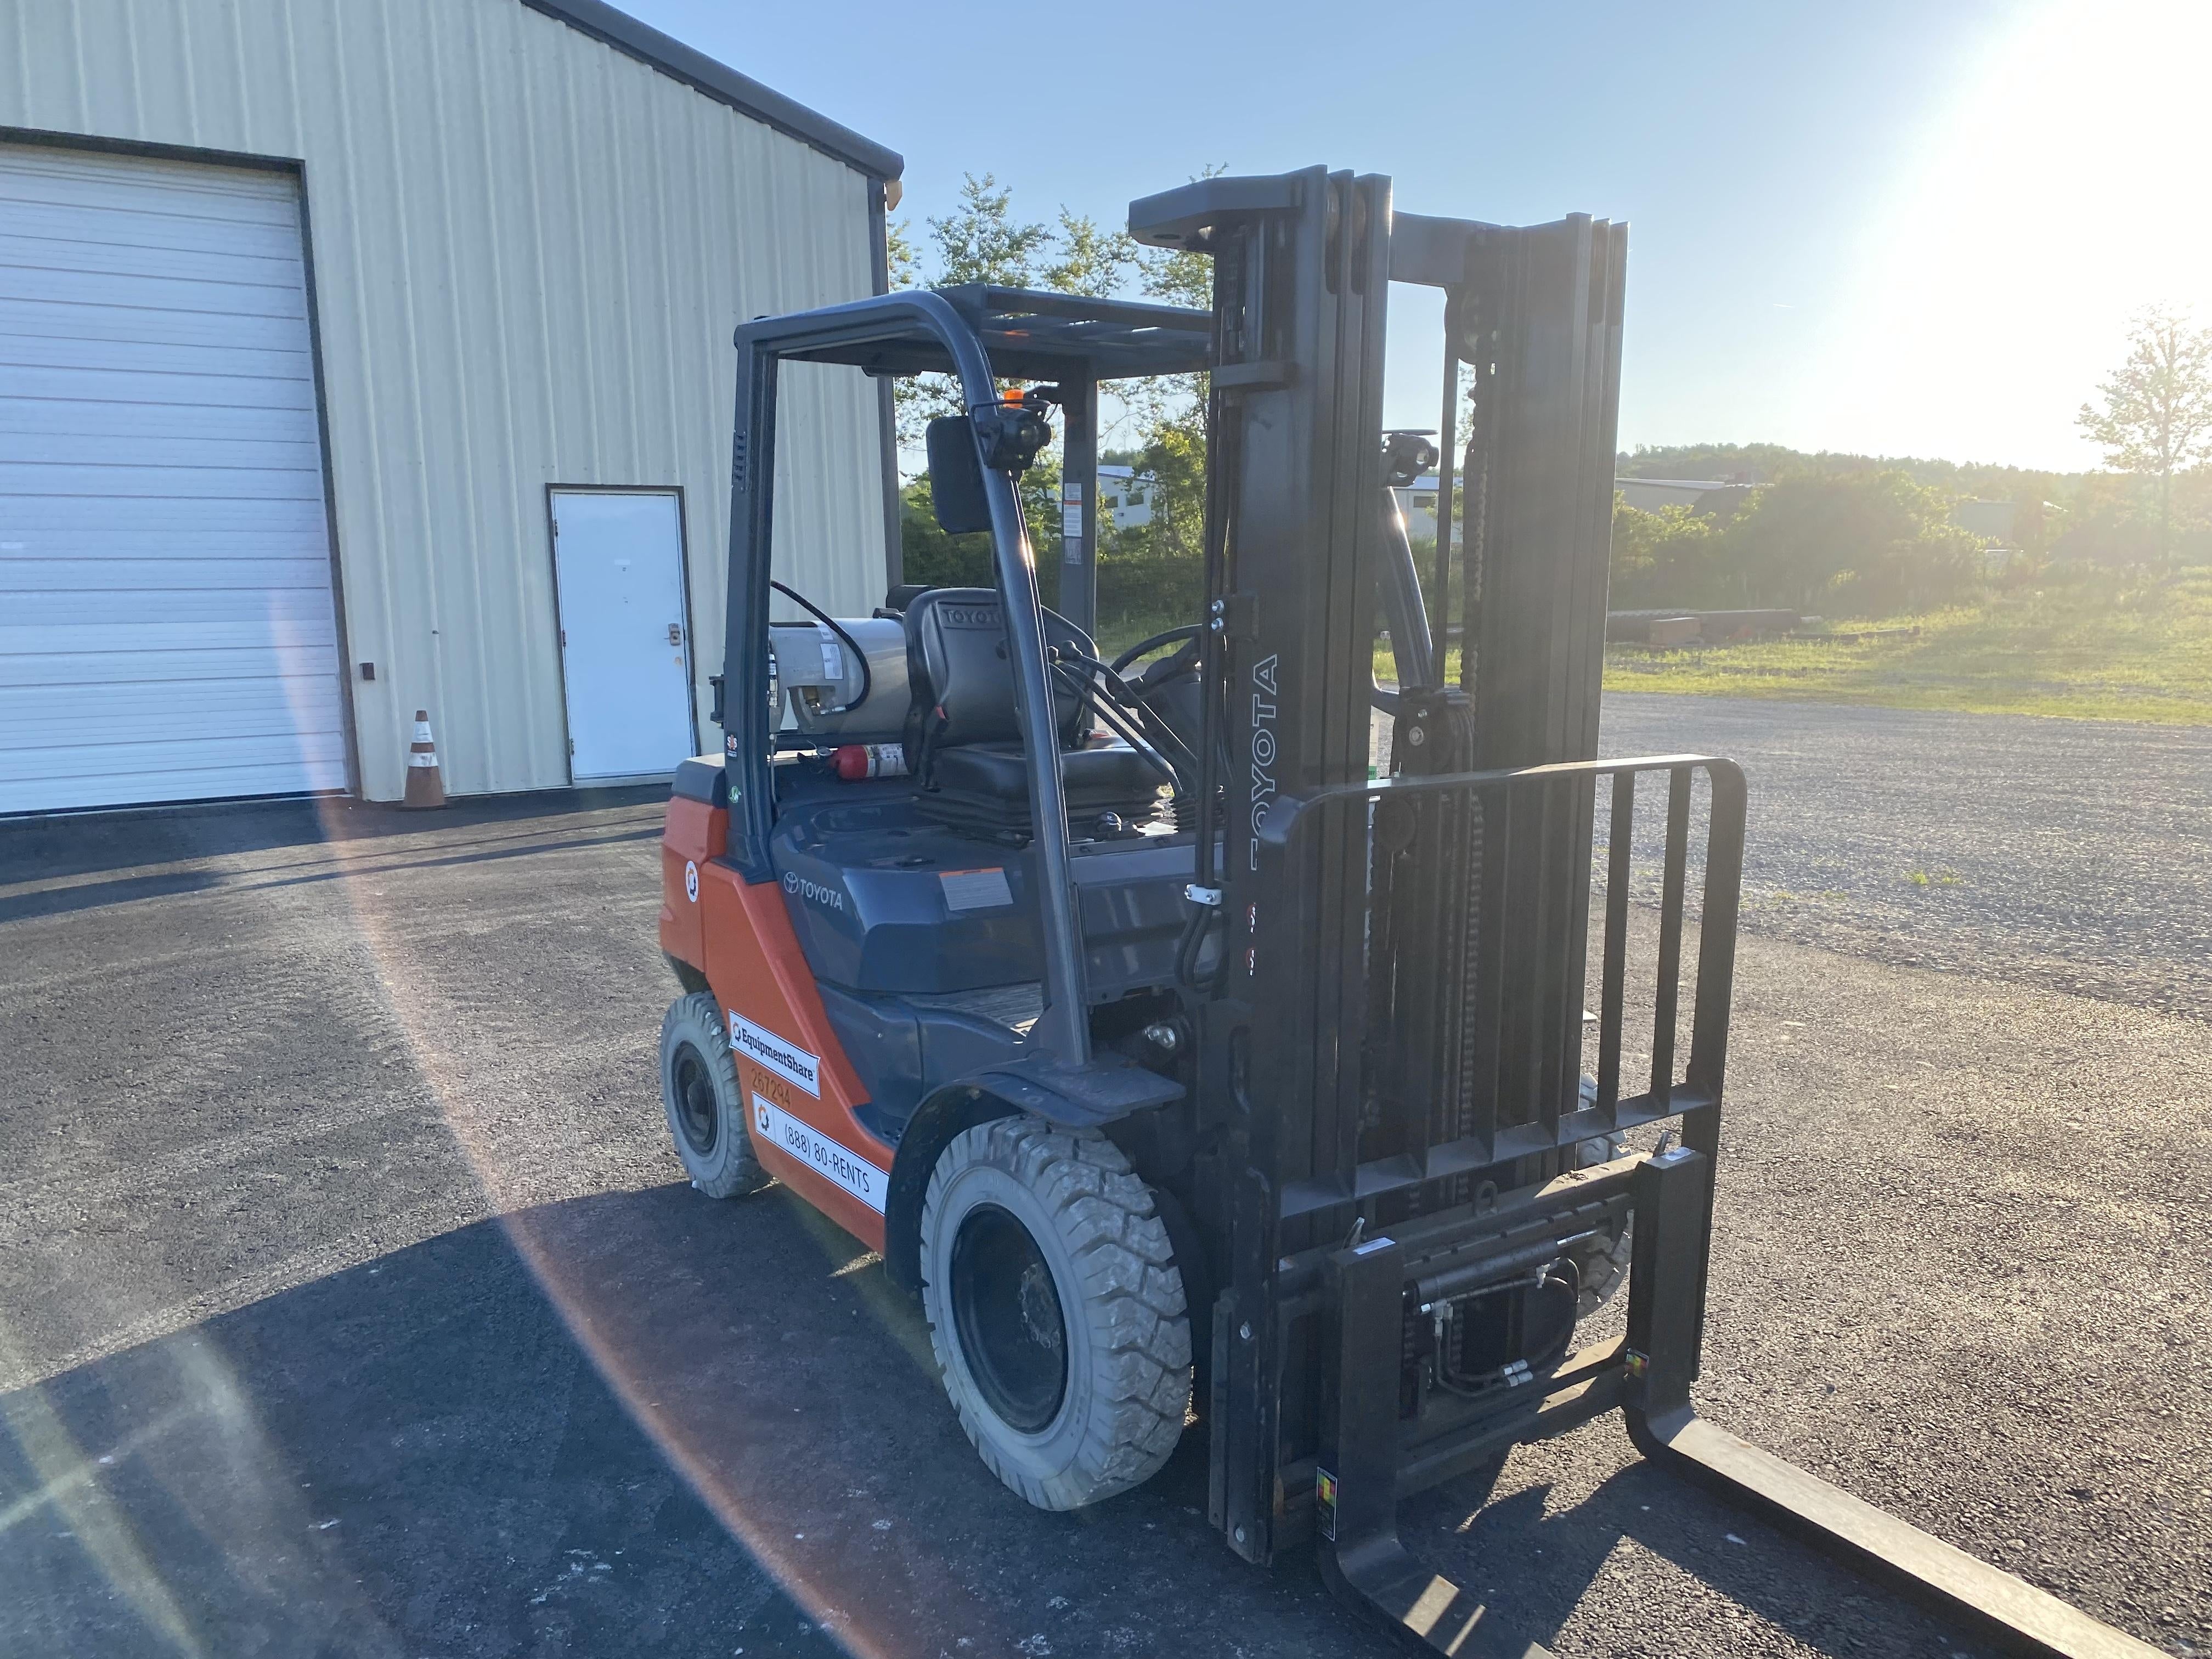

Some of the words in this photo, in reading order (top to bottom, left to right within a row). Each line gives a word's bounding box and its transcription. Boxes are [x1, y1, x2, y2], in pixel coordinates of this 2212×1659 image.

[943, 609, 1001, 624] TOYOT
[800, 879, 843, 911] TOYOTA
[741, 1027, 814, 1082] EquipmentShare
[751, 1068, 791, 1108] 267294
[786, 1123, 811, 1158] (888)
[814, 1143, 870, 1193] 80-RENTS
